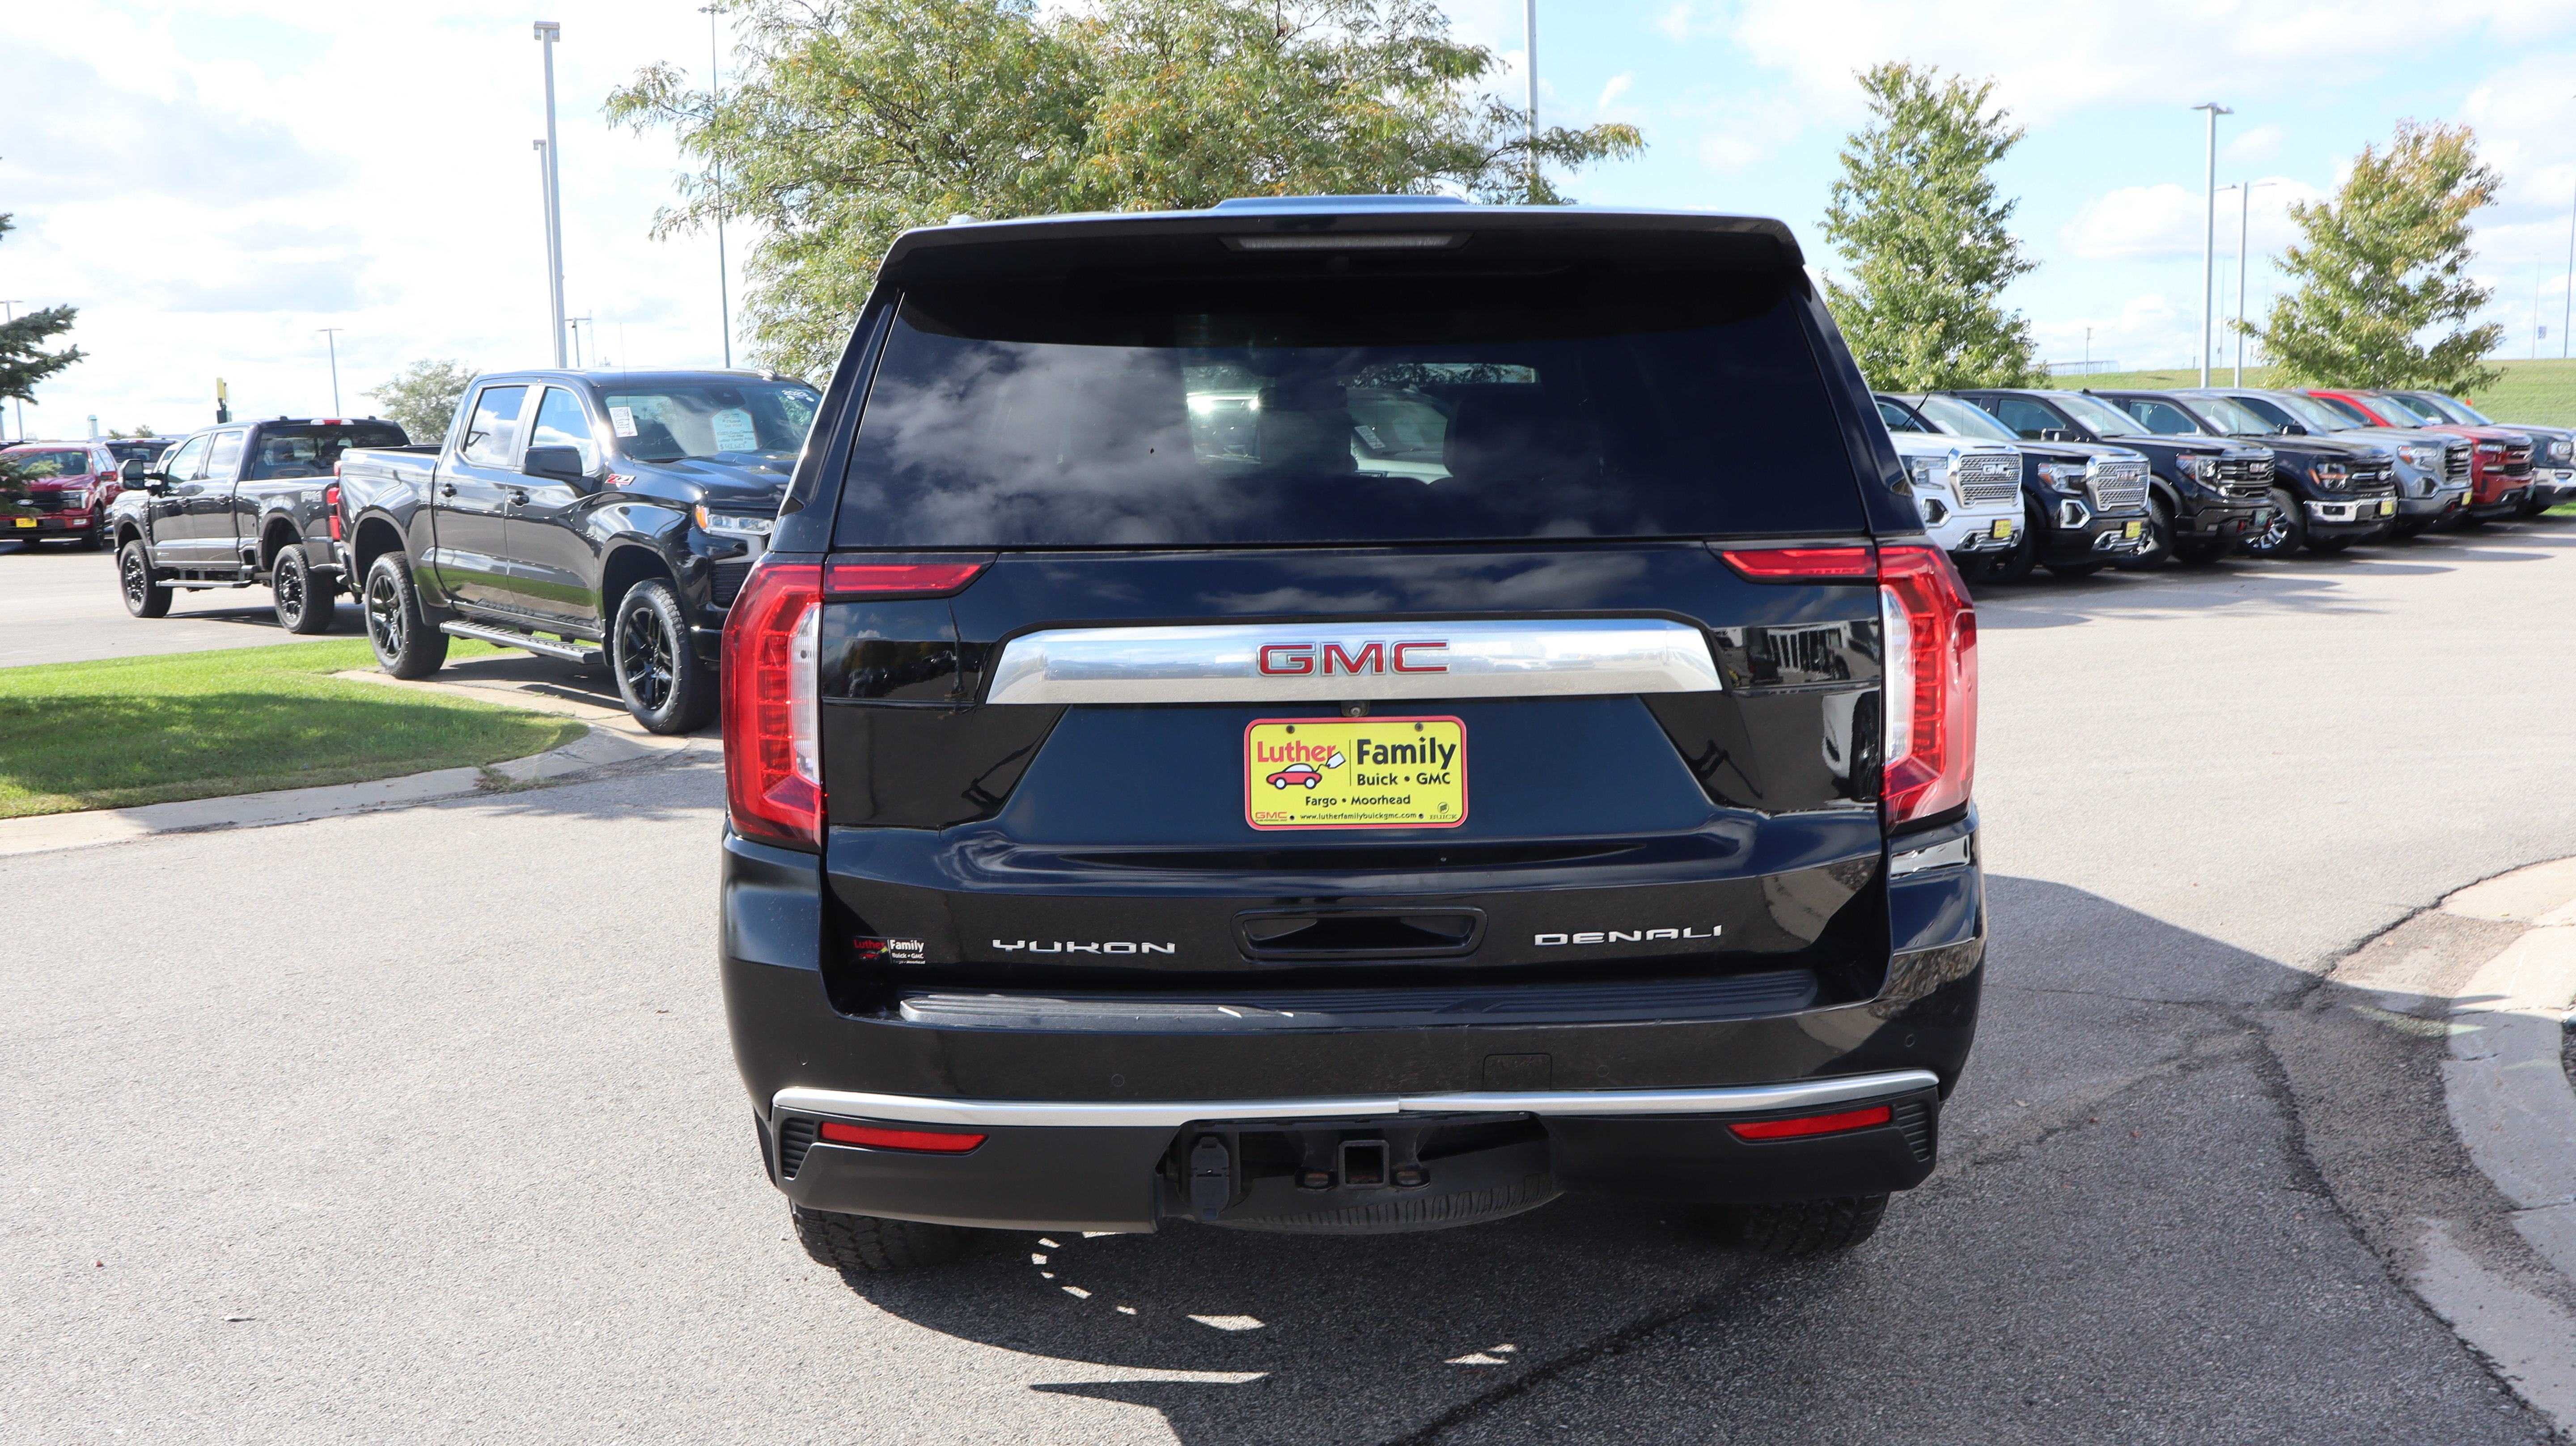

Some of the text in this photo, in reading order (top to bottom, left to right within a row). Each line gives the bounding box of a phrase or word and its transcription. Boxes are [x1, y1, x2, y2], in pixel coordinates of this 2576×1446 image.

[1257, 640, 1450, 676] GMC
[1257, 737, 1457, 769] Luther Family
[1357, 772, 1451, 786] Buick GMC
[1305, 794, 1411, 808] Fargo Moorhead
[1300, 812, 1417, 821] www.lutherfamilybuickgmc.com
[1534, 924, 1722, 946] DENALI
[853, 938, 924, 953] Luther Family
[993, 939, 1175, 954] YUKON
